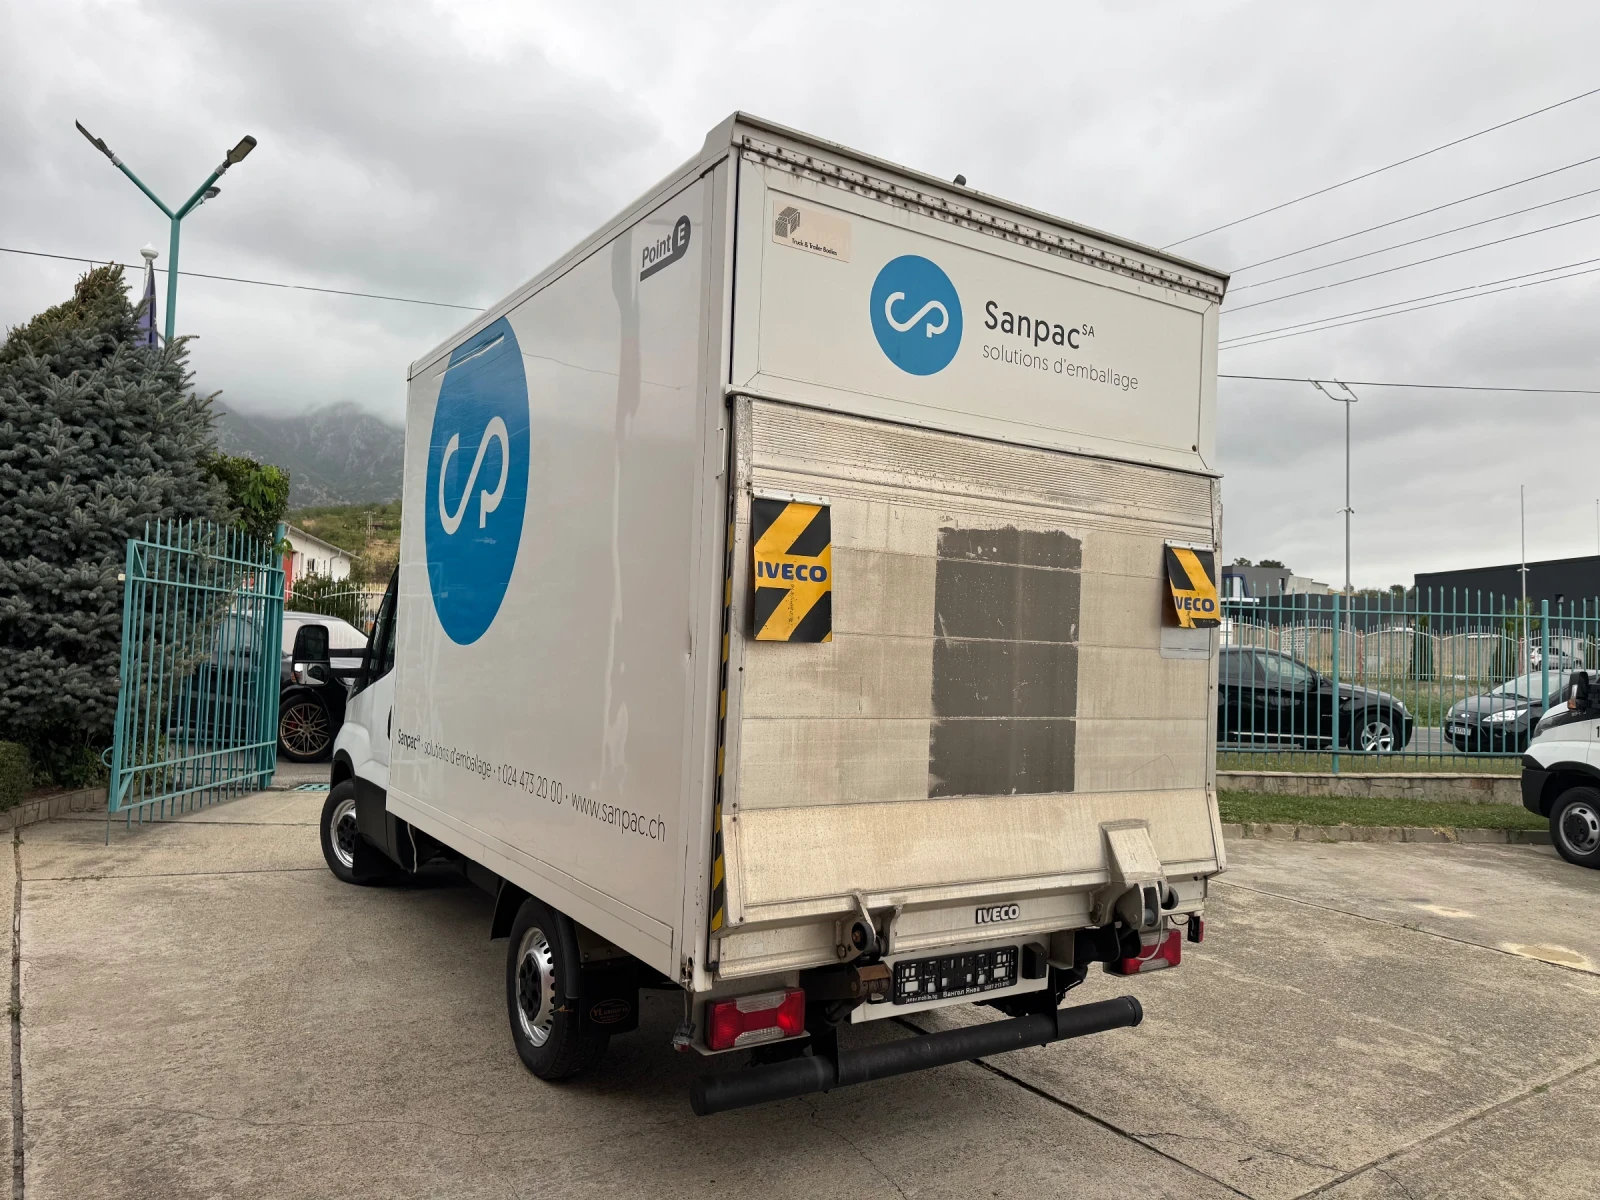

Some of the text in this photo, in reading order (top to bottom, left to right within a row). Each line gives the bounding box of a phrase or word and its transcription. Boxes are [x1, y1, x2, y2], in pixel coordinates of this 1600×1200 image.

[642, 234, 671, 268] Point
[792, 237, 804, 247] Truck
[809, 242, 823, 251] Trailer
[823, 246, 837, 255] Bodies
[984, 300, 1080, 349] Sanpac
[982, 344, 1139, 391] solutions d'emballage
[757, 560, 827, 582] IVECO
[1174, 595, 1215, 612] VECO
[424, 740, 450, 762] solutions
[450, 747, 492, 780] d'emballage
[502, 764, 517, 787] 024
[519, 770, 535, 794] 473
[536, 775, 548, 799] 20
[550, 780, 563, 804] 00
[571, 792, 666, 842] www.sanpac.ch
[976, 903, 1020, 924] IVECO
